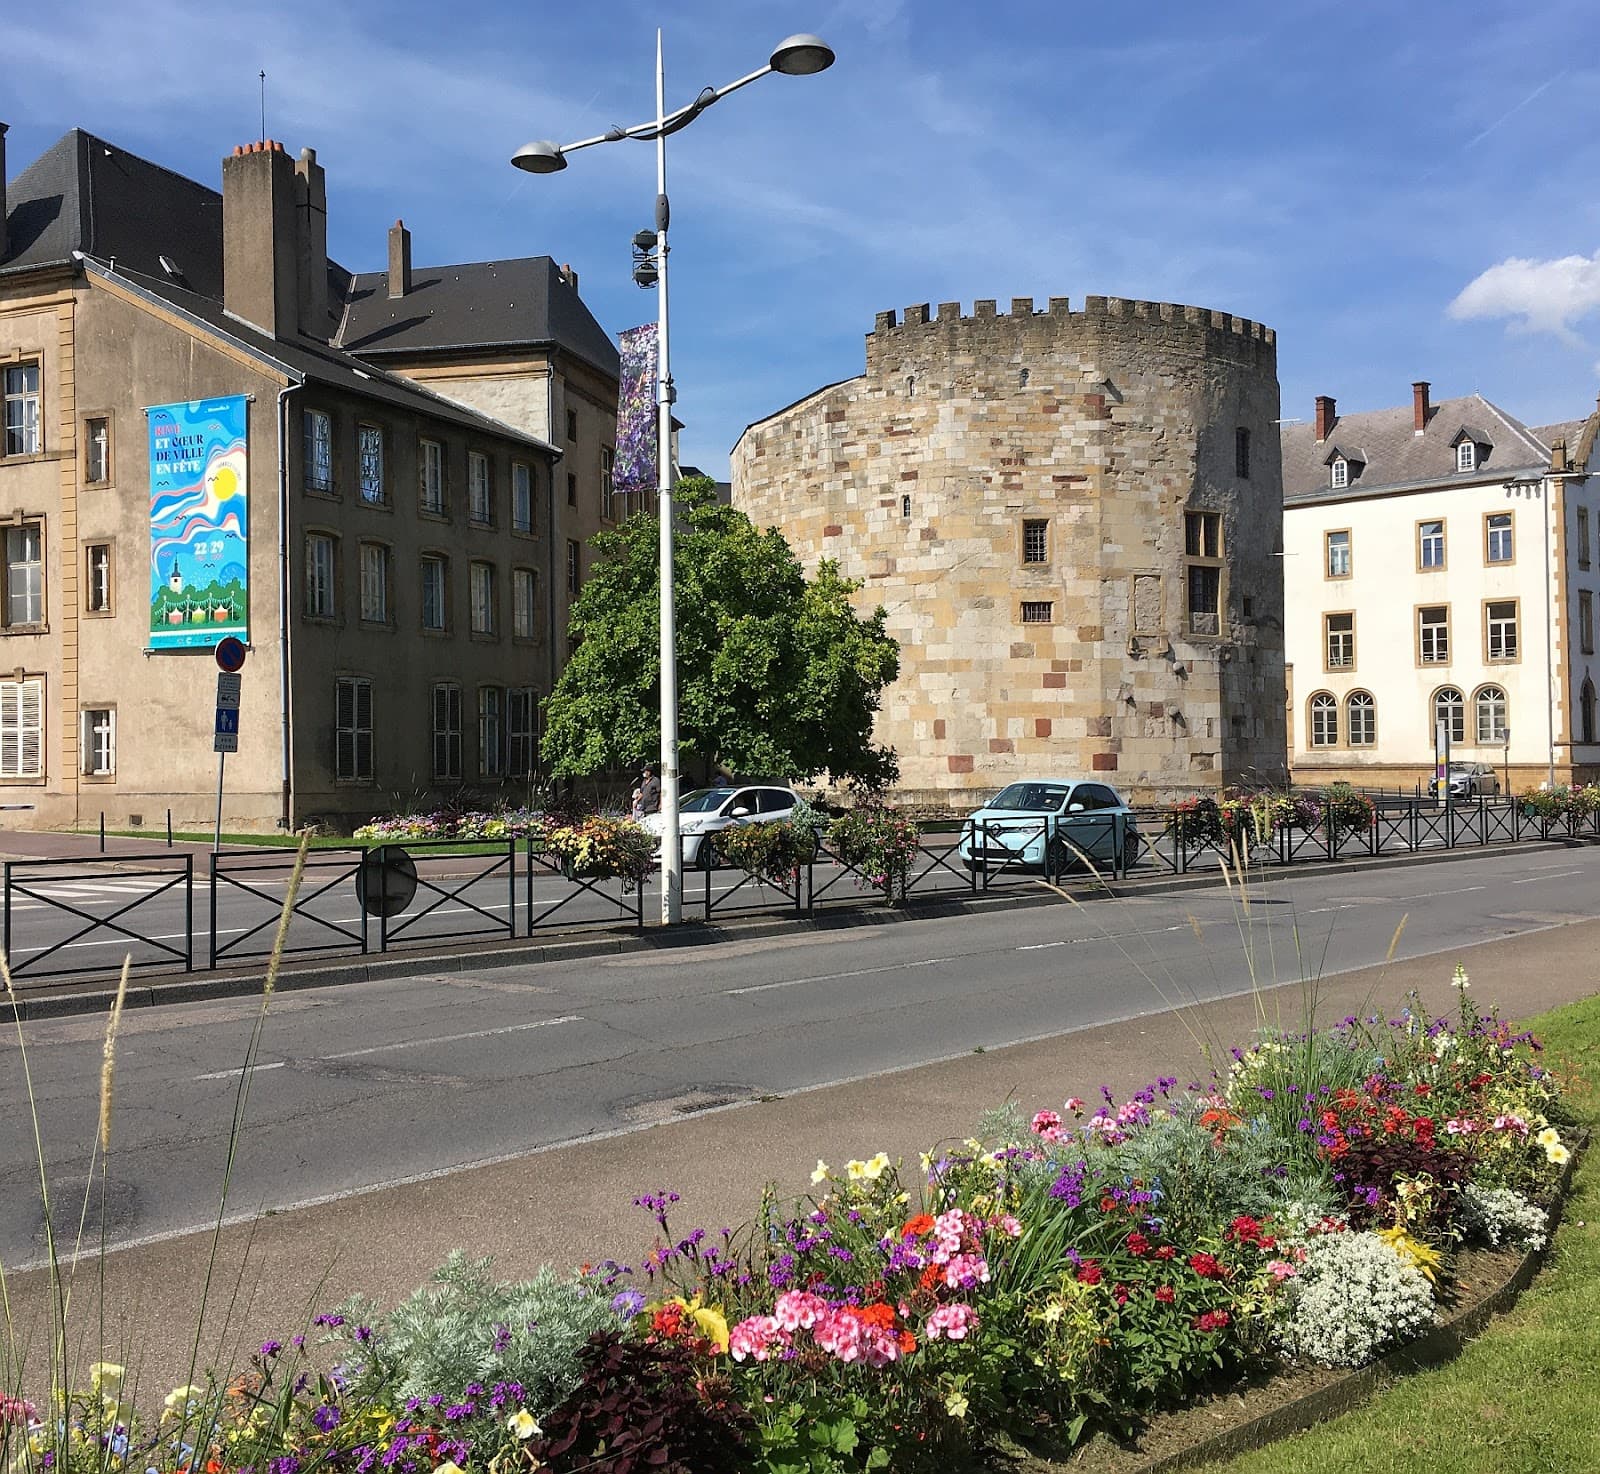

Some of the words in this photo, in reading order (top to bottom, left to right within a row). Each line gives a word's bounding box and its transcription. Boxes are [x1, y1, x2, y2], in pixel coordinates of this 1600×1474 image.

[155, 437, 170, 449] ET
[172, 434, 203, 447] CŒUR
[156, 450, 171, 461] DE
[173, 447, 204, 460] VILLE
[156, 463, 171, 475] EN
[172, 459, 200, 473] FÊTE
[194, 542, 207, 555] 22
[211, 540, 224, 553] 29
